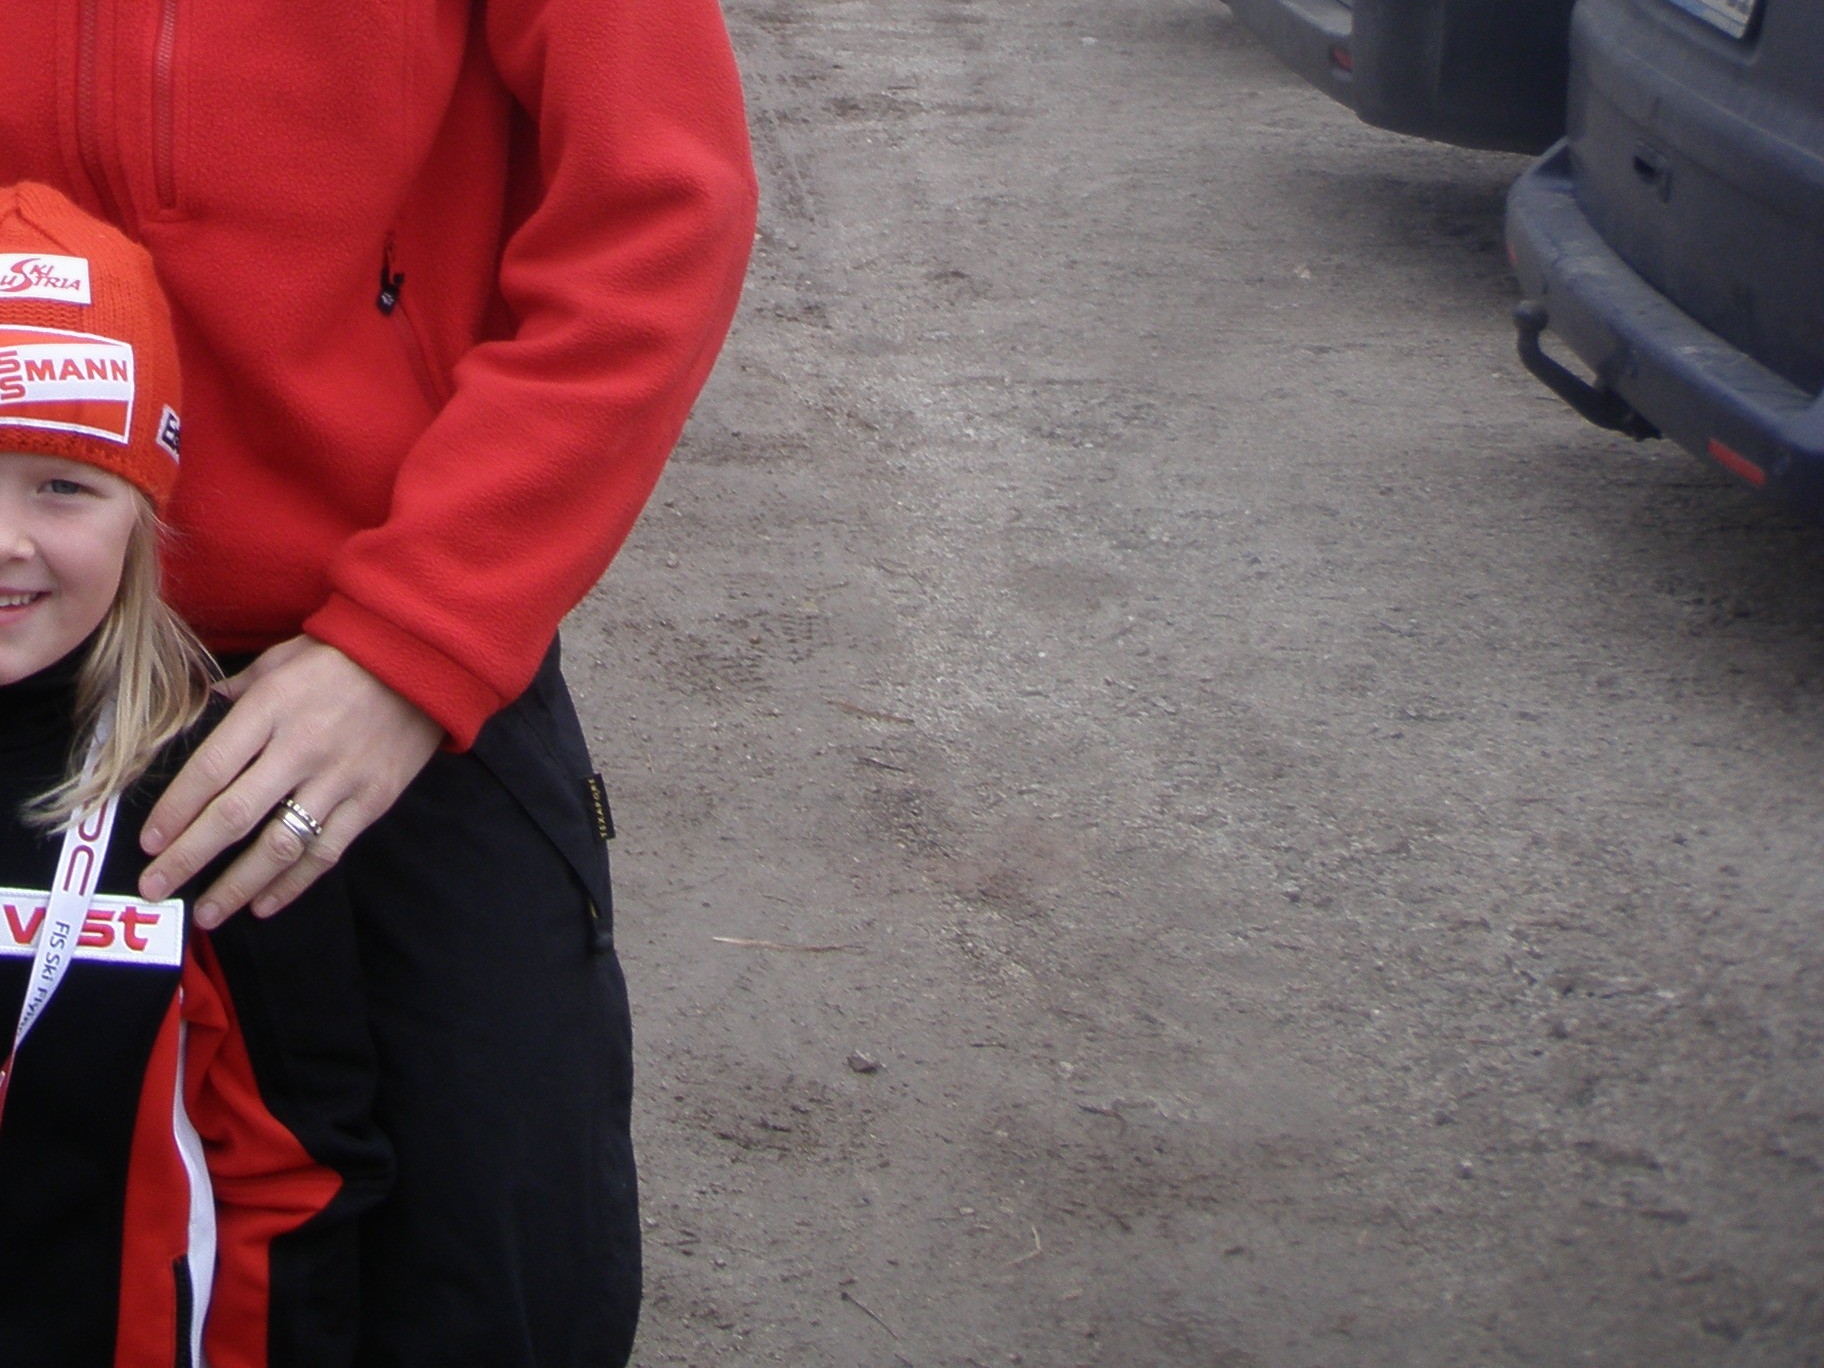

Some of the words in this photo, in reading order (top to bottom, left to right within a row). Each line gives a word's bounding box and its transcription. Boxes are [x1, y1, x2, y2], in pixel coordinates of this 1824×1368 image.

[3, 905, 161, 953] vst
[48, 920, 71, 950] FIS
[42, 951, 61, 983] Ski
